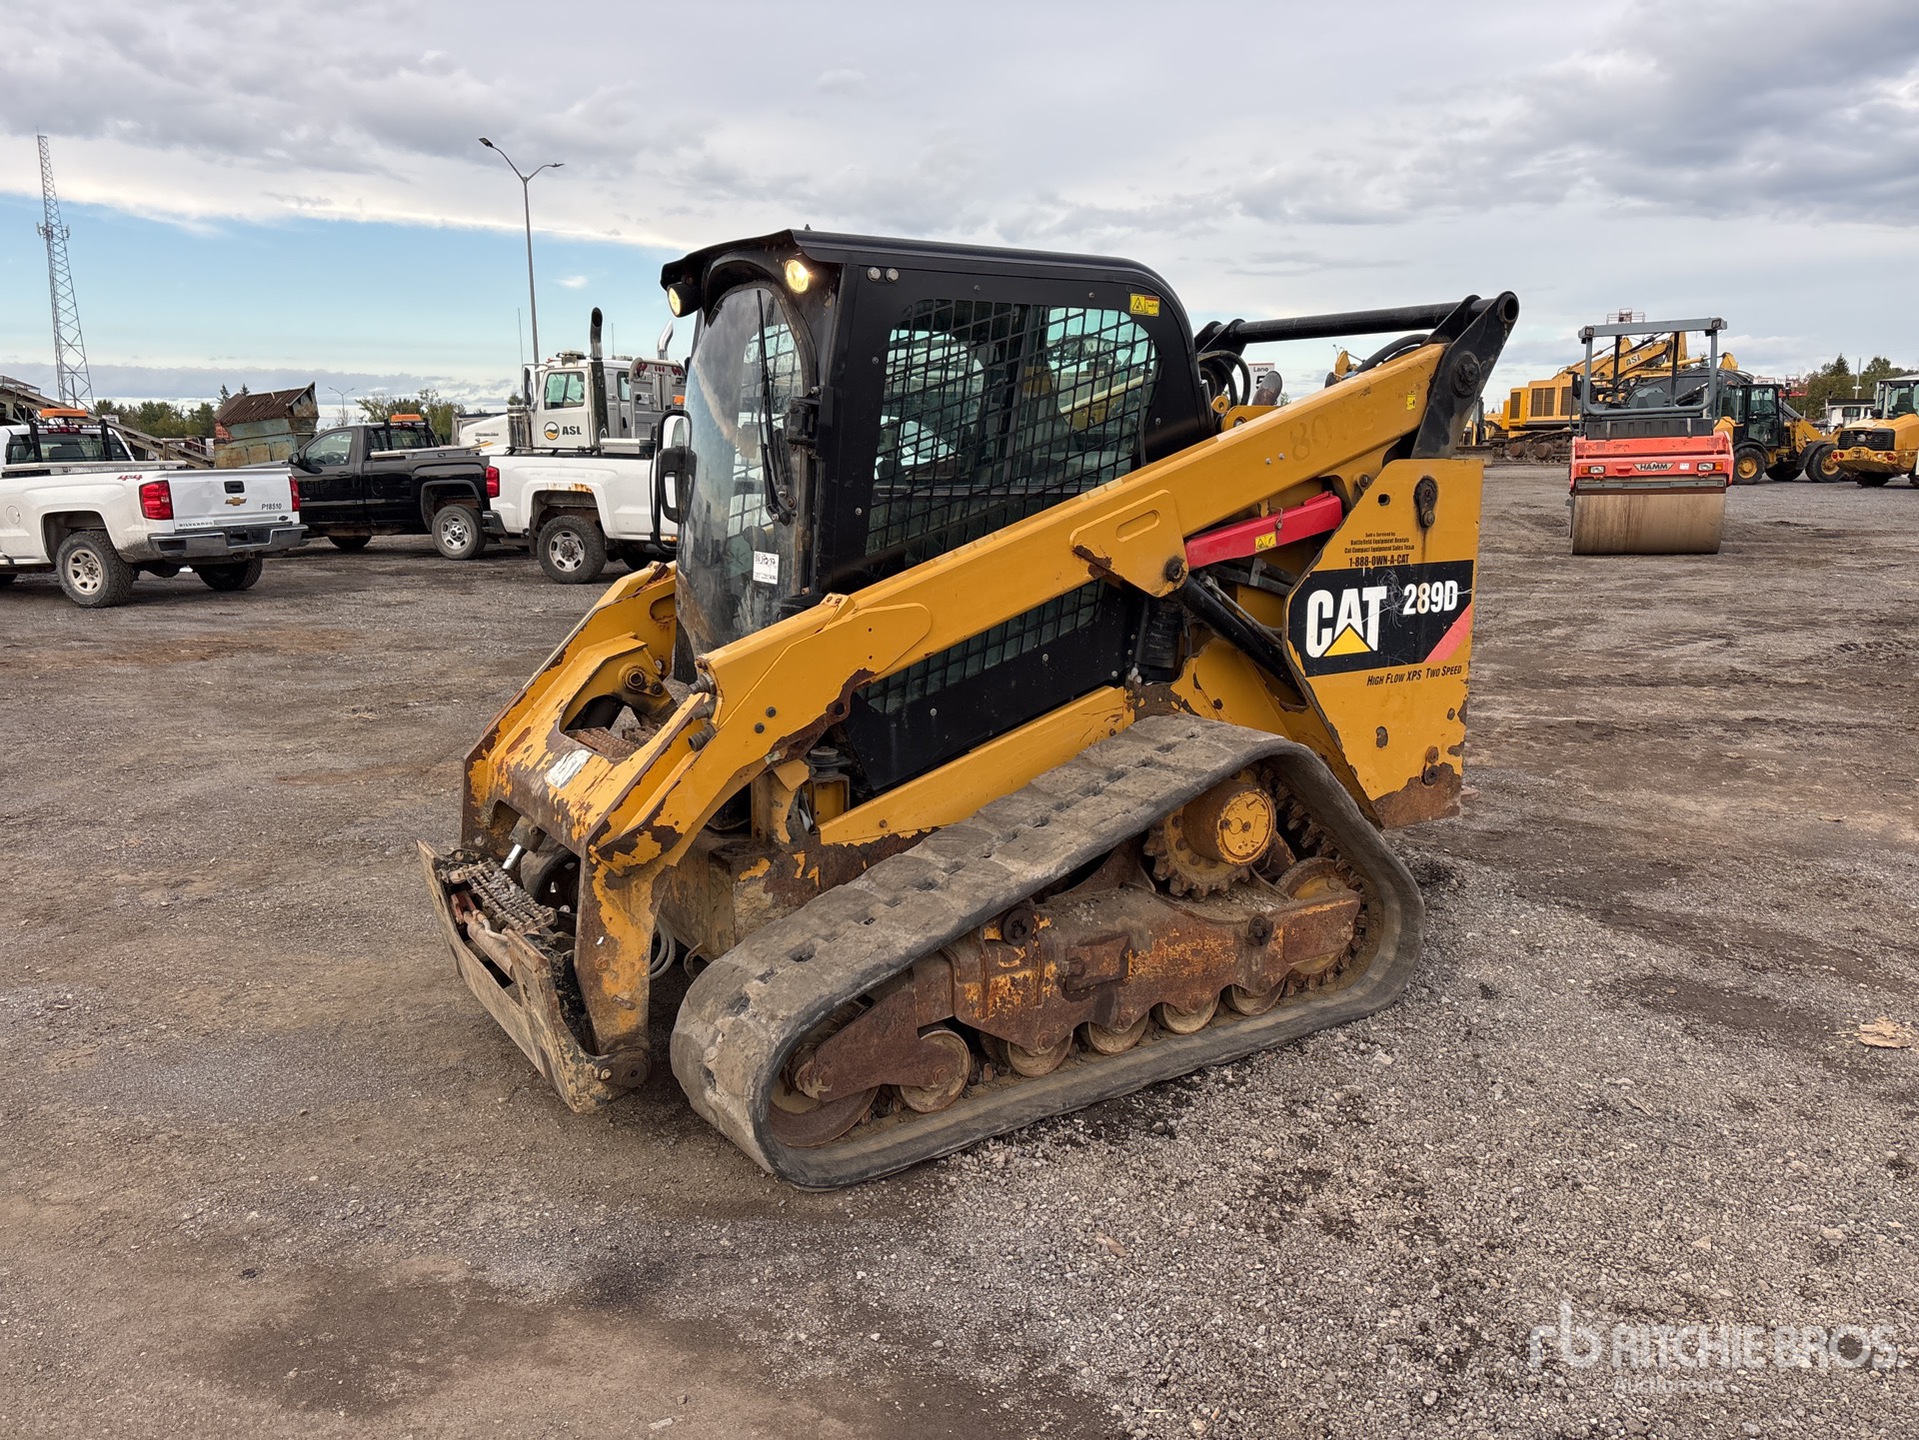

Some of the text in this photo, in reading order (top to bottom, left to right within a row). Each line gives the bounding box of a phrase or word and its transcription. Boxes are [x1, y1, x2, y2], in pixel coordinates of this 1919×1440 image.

[1626, 353, 1642, 367] ASL
[562, 425, 582, 436] ASL
[1640, 463, 1668, 471] HAMM
[261, 502, 283, 511] P18510
[1352, 546, 1371, 554] Compact
[1371, 545, 1392, 553] Equipment
[1349, 554, 1410, 568] 1-888-OWN-A-CAT
[1306, 580, 1459, 659] CAT 289D
[1406, 669, 1422, 682] XPS
